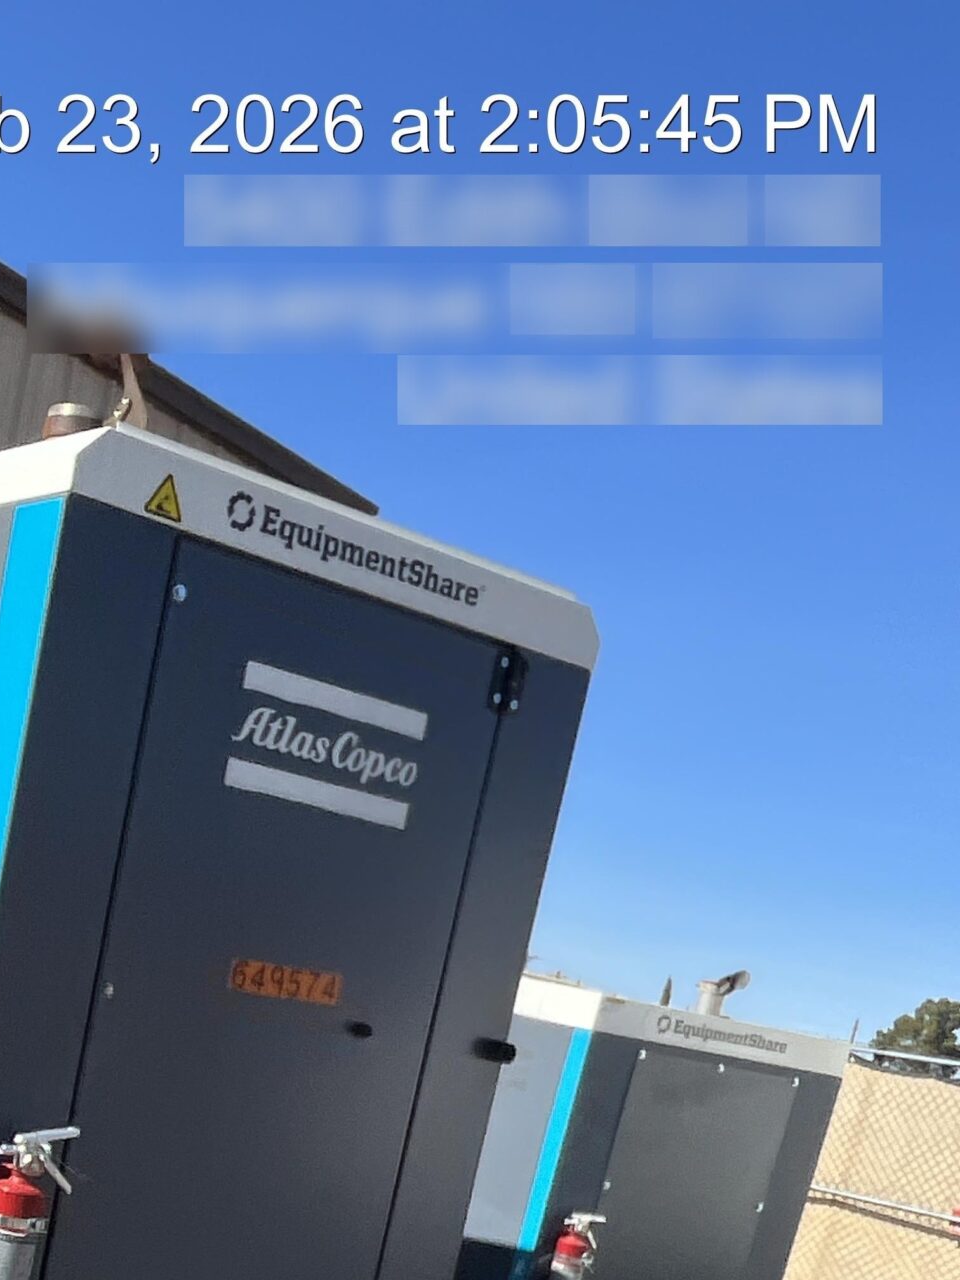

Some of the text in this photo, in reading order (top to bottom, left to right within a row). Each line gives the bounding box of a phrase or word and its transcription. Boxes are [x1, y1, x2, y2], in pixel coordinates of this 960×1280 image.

[259, 504, 480, 606] EquipmentShare
[231, 706, 414, 787] Atlas Copco
[233, 960, 336, 1000] 649574
[674, 1019, 788, 1053] EquipmentShare
